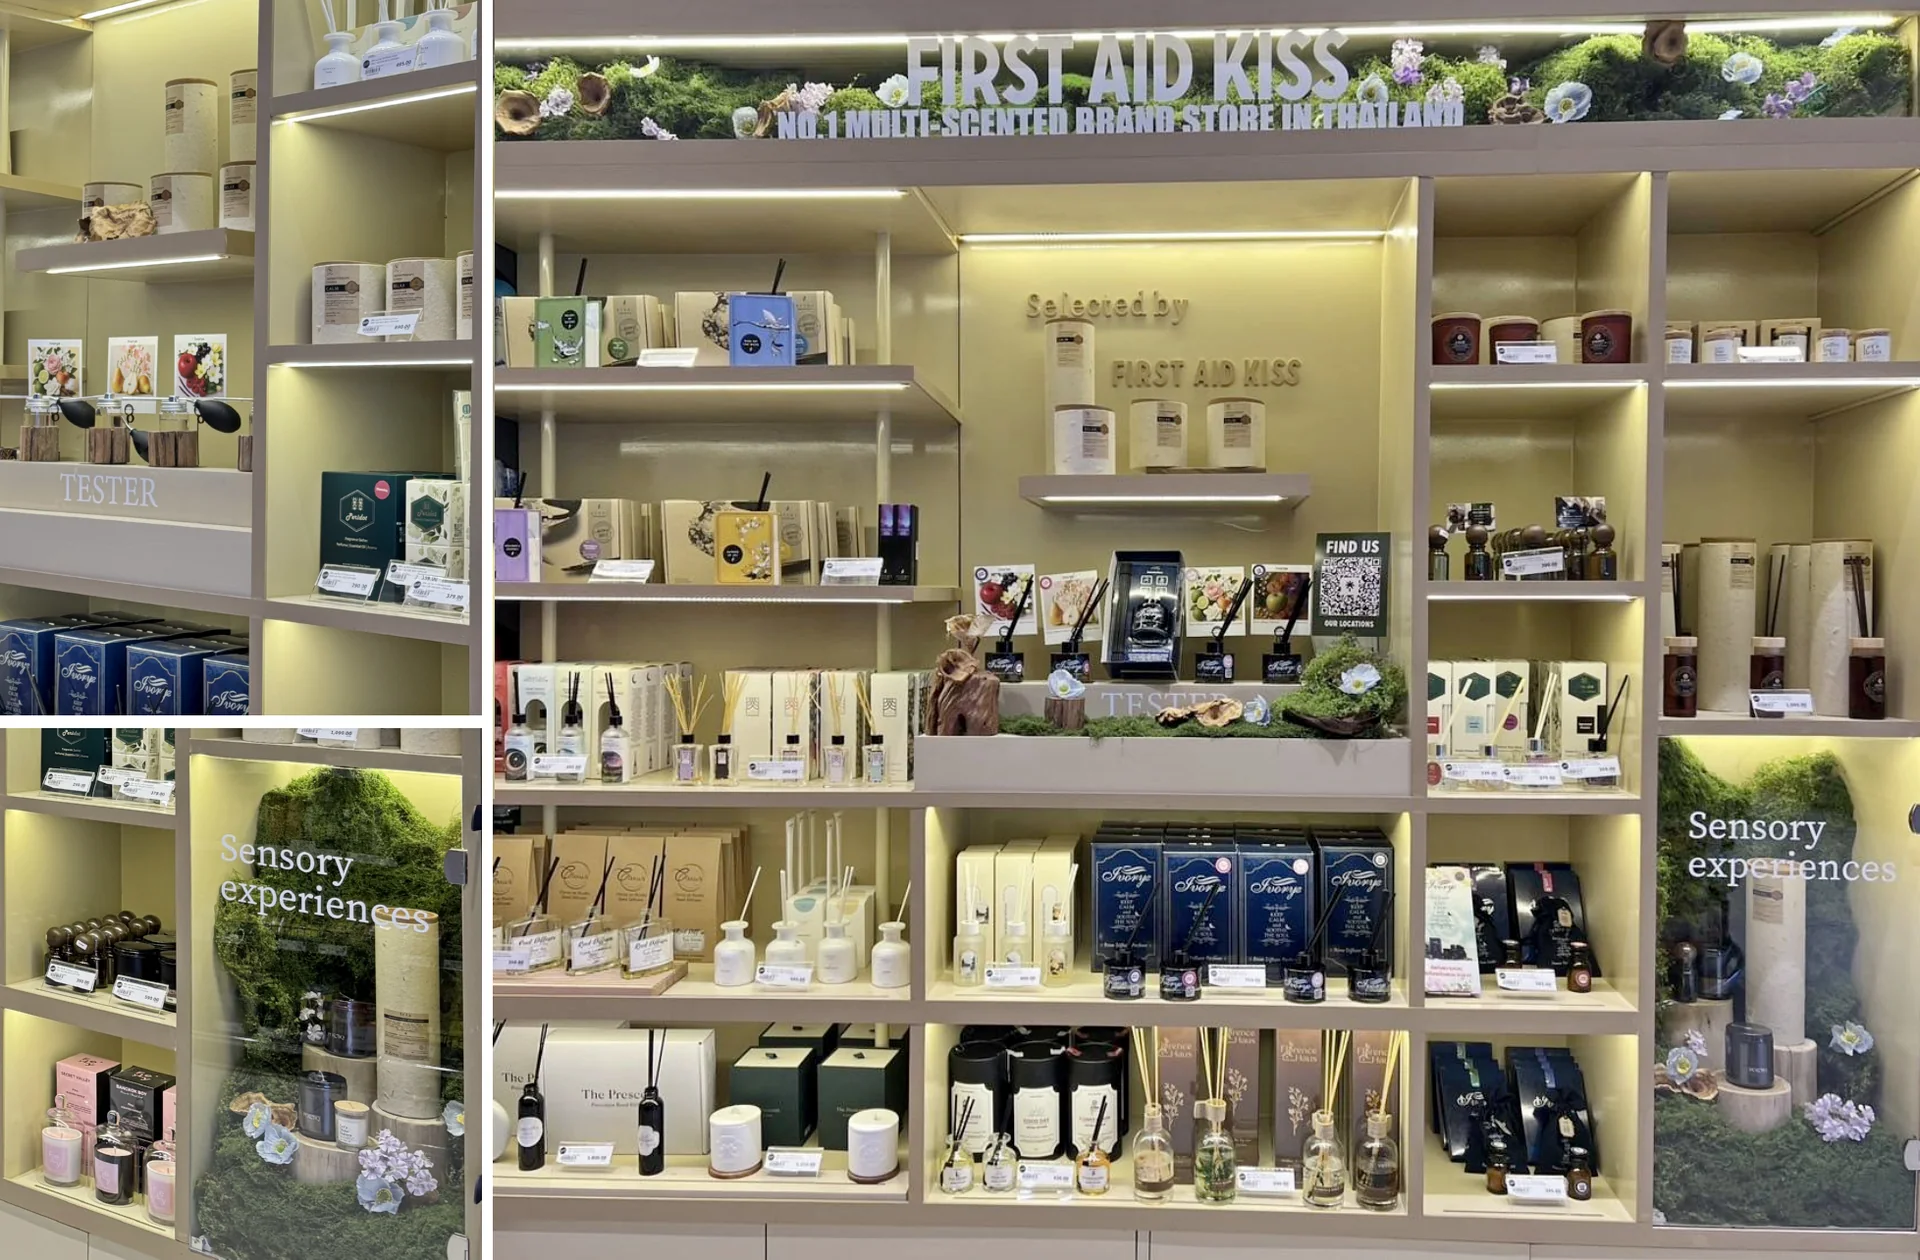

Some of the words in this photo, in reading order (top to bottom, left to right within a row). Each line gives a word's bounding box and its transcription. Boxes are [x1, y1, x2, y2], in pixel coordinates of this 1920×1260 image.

[907, 34, 1074, 106] FIRST
[1088, 33, 1193, 103] AID
[1213, 29, 1349, 101] KISS
[778, 110, 838, 139] NO.1
[845, 107, 1068, 138] MULTI-SCENTED
[1075, 105, 1174, 134] BRAND
[1182, 103, 1274, 132] STORE
[1282, 102, 1311, 130] IN
[1322, 100, 1464, 130] THAILAND
[1026, 291, 1147, 318] Selected
[1153, 291, 1189, 326] by
[1112, 360, 1185, 388] FIRST
[1193, 360, 1236, 388] AID
[1243, 358, 1302, 387] KISS
[60, 472, 158, 507] TESTER
[346, 512, 367, 522] Peridot
[1326, 540, 1358, 554] FIND
[1361, 540, 1380, 554] US
[1324, 620, 1337, 628] OUR
[1339, 620, 1374, 628] LOCATIONS
[1689, 811, 1826, 850] Sensory
[220, 834, 354, 887] Sensory
[1688, 850, 1897, 887] experiences
[1251, 876, 1302, 900] Ivorye
[220, 880, 430, 933] experiences
[115, 1083, 138, 1094] BANGKOK
[138, 1089, 147, 1097] BOY
[501, 1072, 524, 1083] The
[581, 1088, 605, 1099] The
